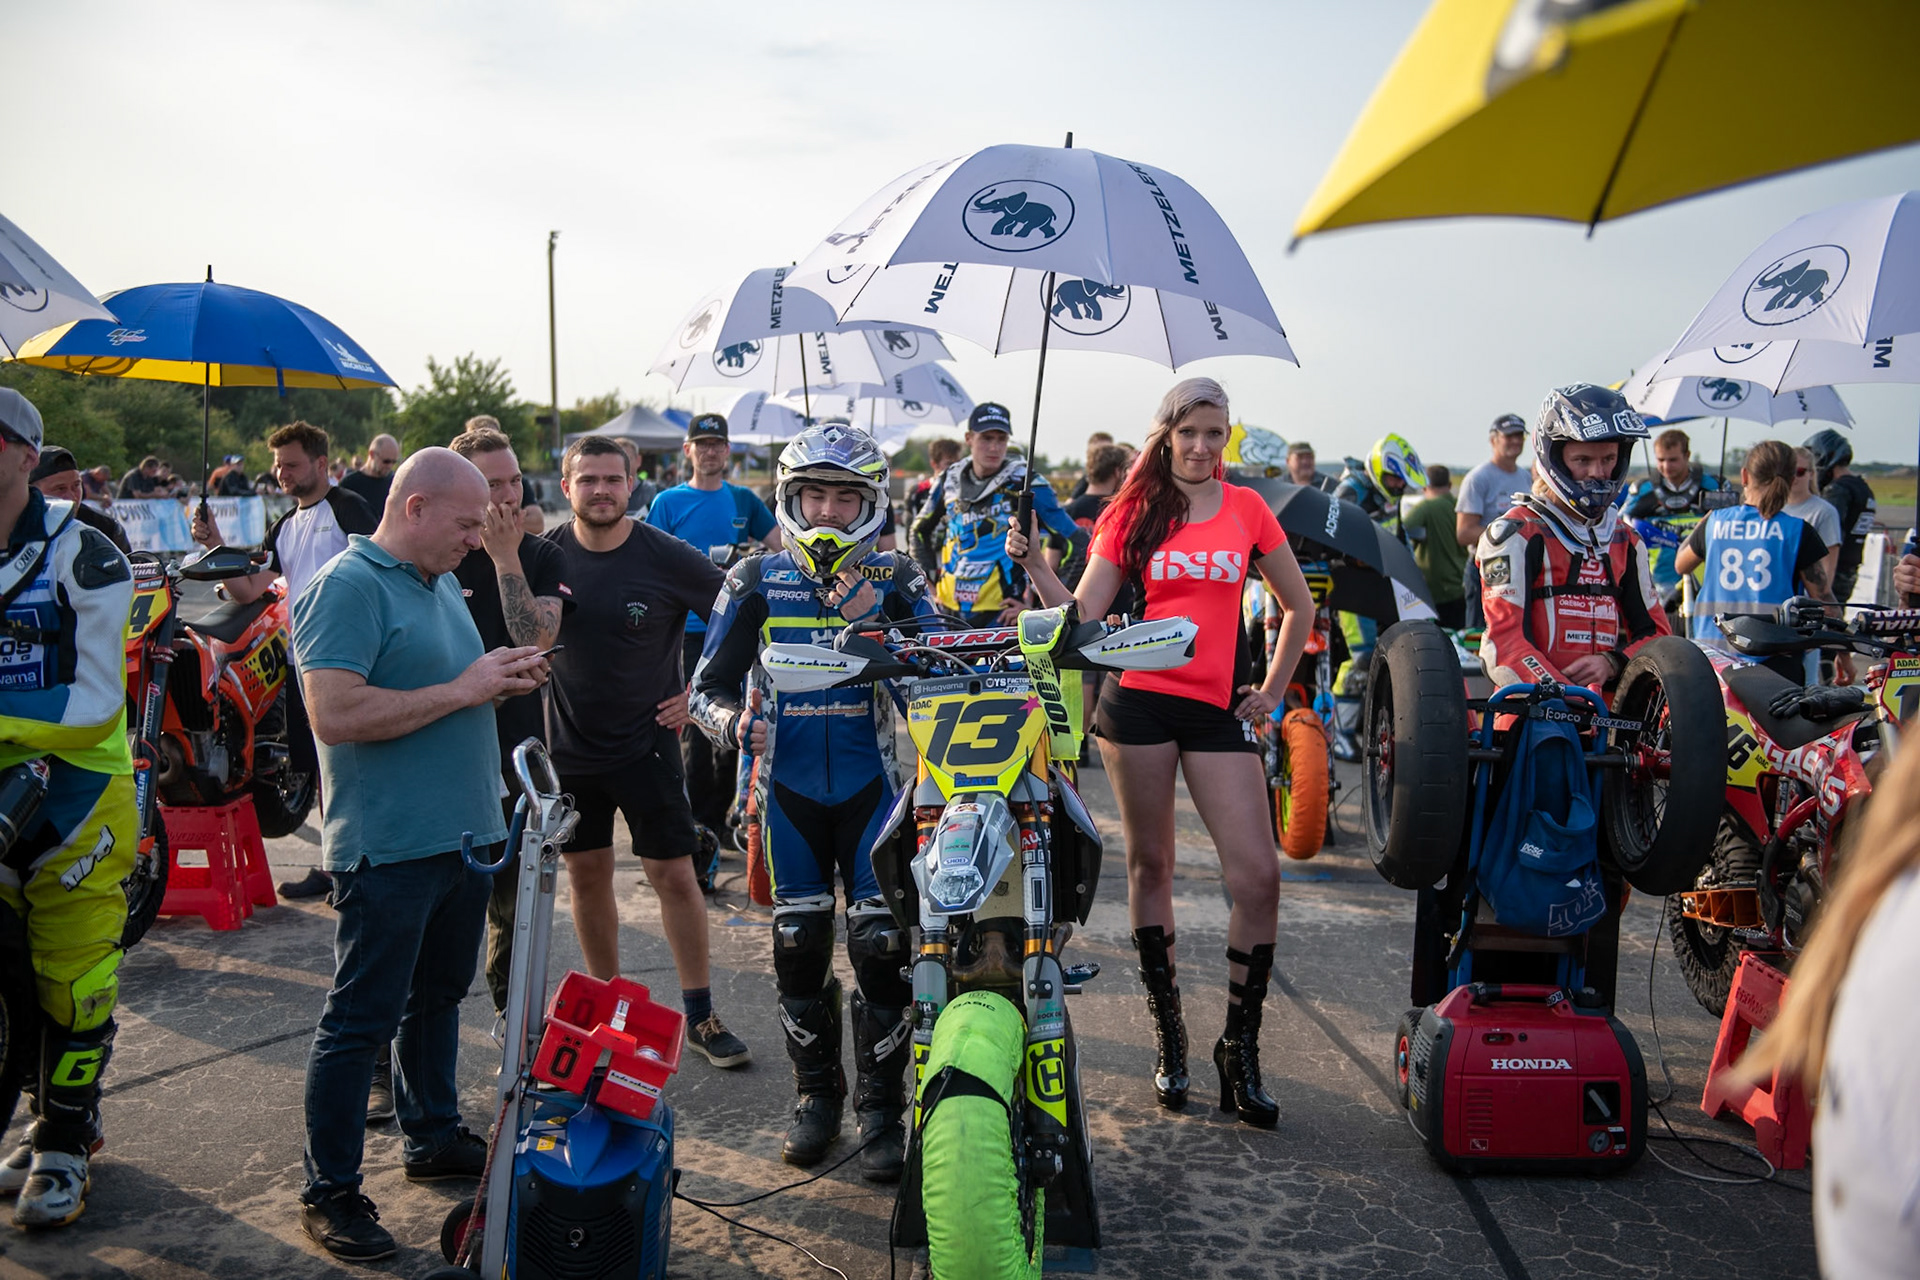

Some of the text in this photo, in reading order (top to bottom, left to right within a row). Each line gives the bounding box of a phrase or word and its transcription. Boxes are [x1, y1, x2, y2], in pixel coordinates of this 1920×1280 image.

[1127, 162, 1199, 285] METZELER
[1713, 520, 1784, 540] MEDIA
[1719, 548, 1772, 591] 83
[766, 589, 810, 599] BERGOS
[923, 682, 964, 693] Husqvarna
[910, 700, 932, 710] ADAC
[926, 698, 1030, 769] 13
[1491, 1058, 1572, 1070] HONDA
